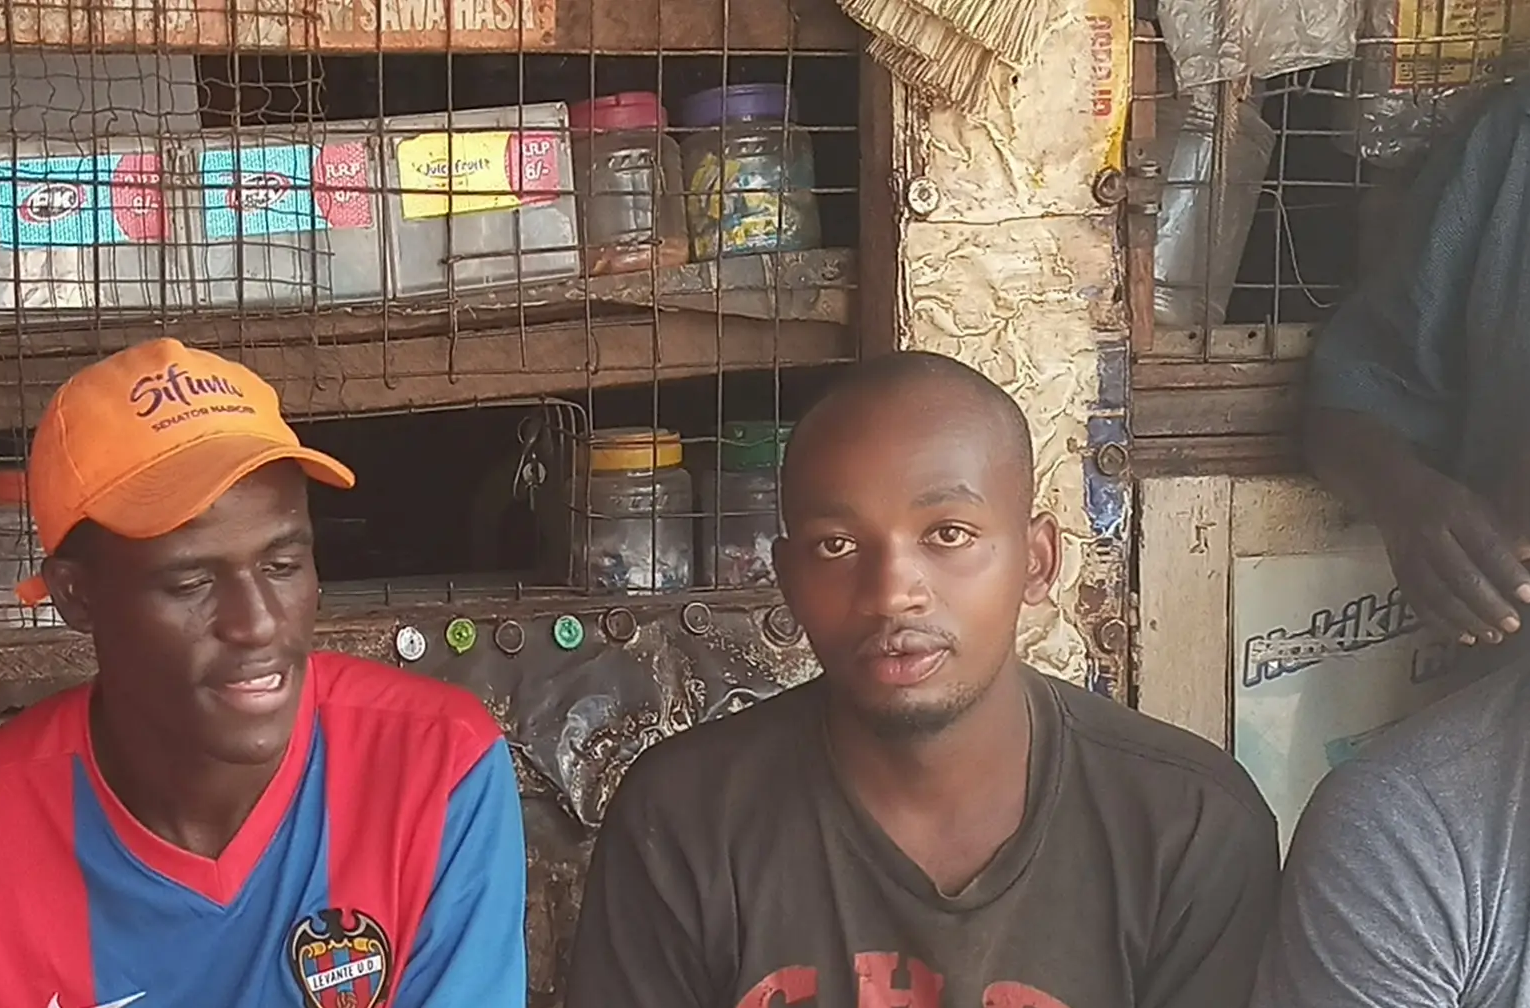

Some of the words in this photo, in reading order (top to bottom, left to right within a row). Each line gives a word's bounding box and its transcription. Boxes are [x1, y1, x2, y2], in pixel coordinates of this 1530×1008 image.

[425, 163, 448, 176] Juic
[151, 407, 209, 432] SENATOR
[312, 965, 354, 989] LEVANTE
